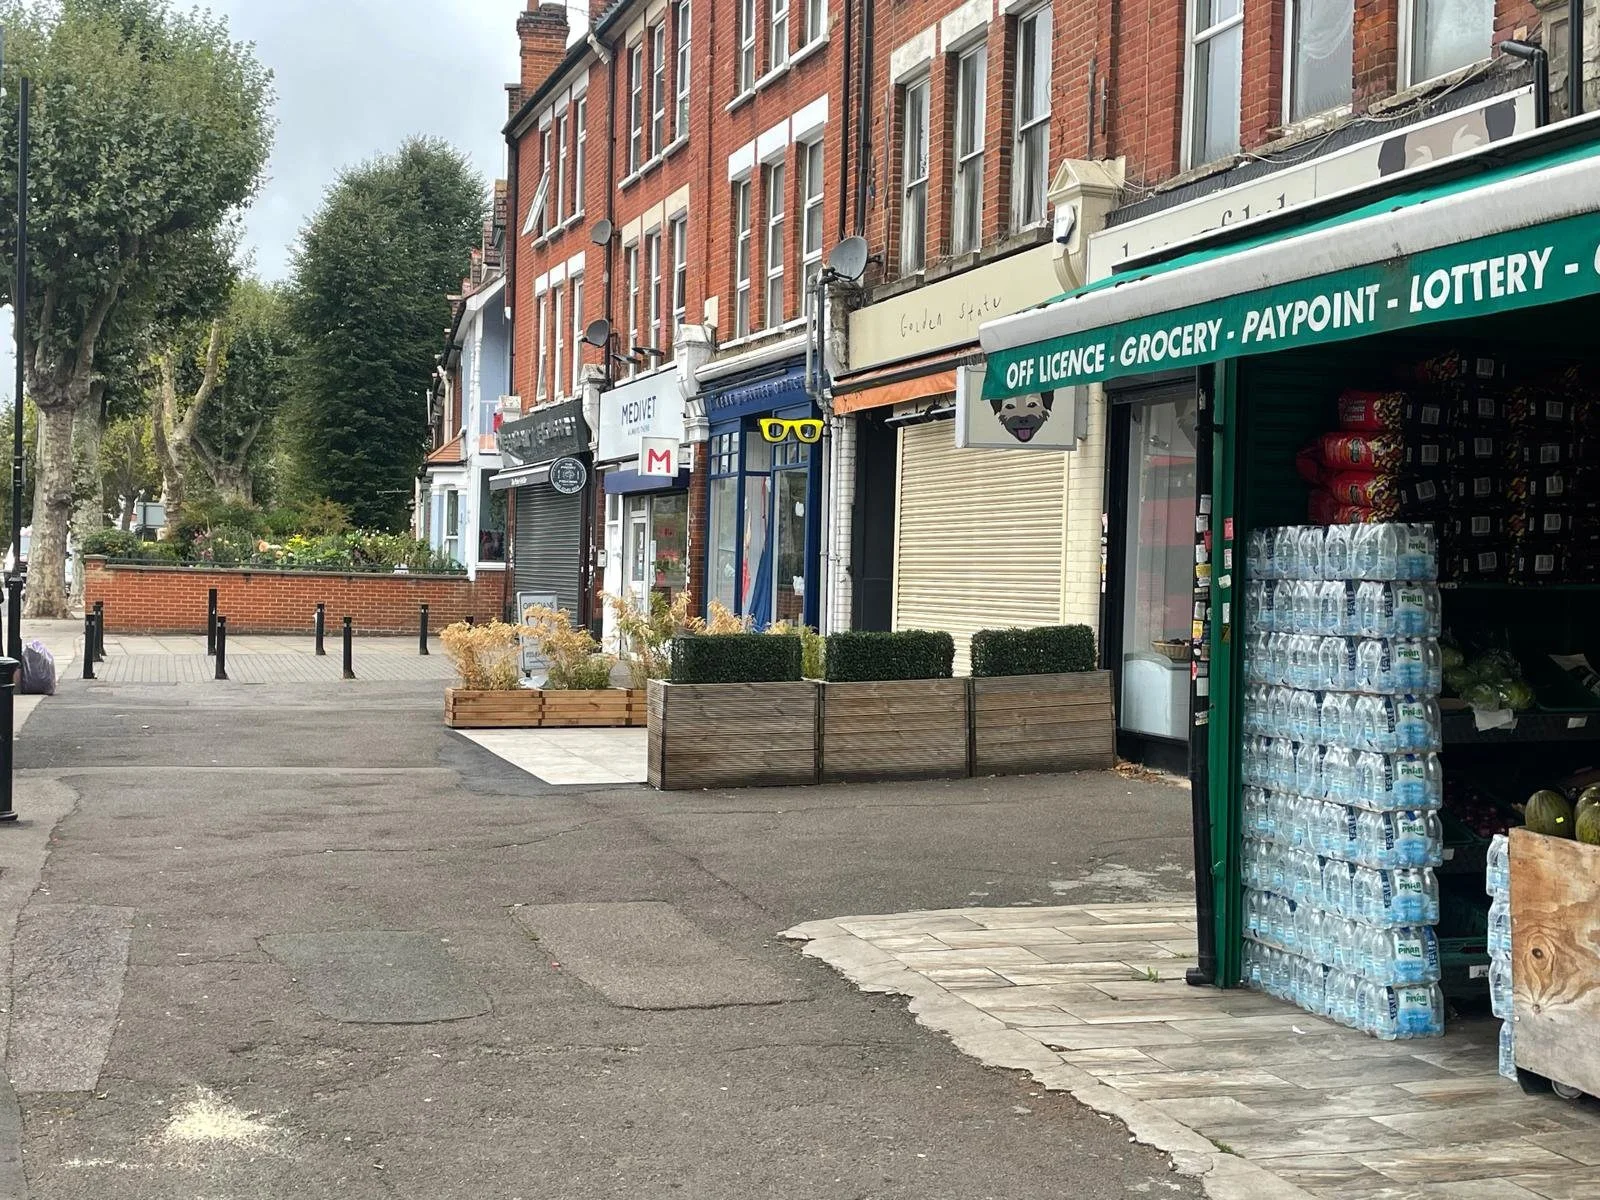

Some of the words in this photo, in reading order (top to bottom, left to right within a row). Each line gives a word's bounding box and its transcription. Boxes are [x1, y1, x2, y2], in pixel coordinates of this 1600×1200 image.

[901, 308, 944, 338] Golden
[1006, 357, 1035, 390] OFF
[1039, 343, 1105, 382] LICENCE
[1119, 318, 1223, 367] GROCERY
[1241, 283, 1381, 344] PAYPOINT
[1409, 246, 1554, 313] LOTTERY
[621, 395, 657, 426] MEDIVET
[647, 448, 671, 474] M
